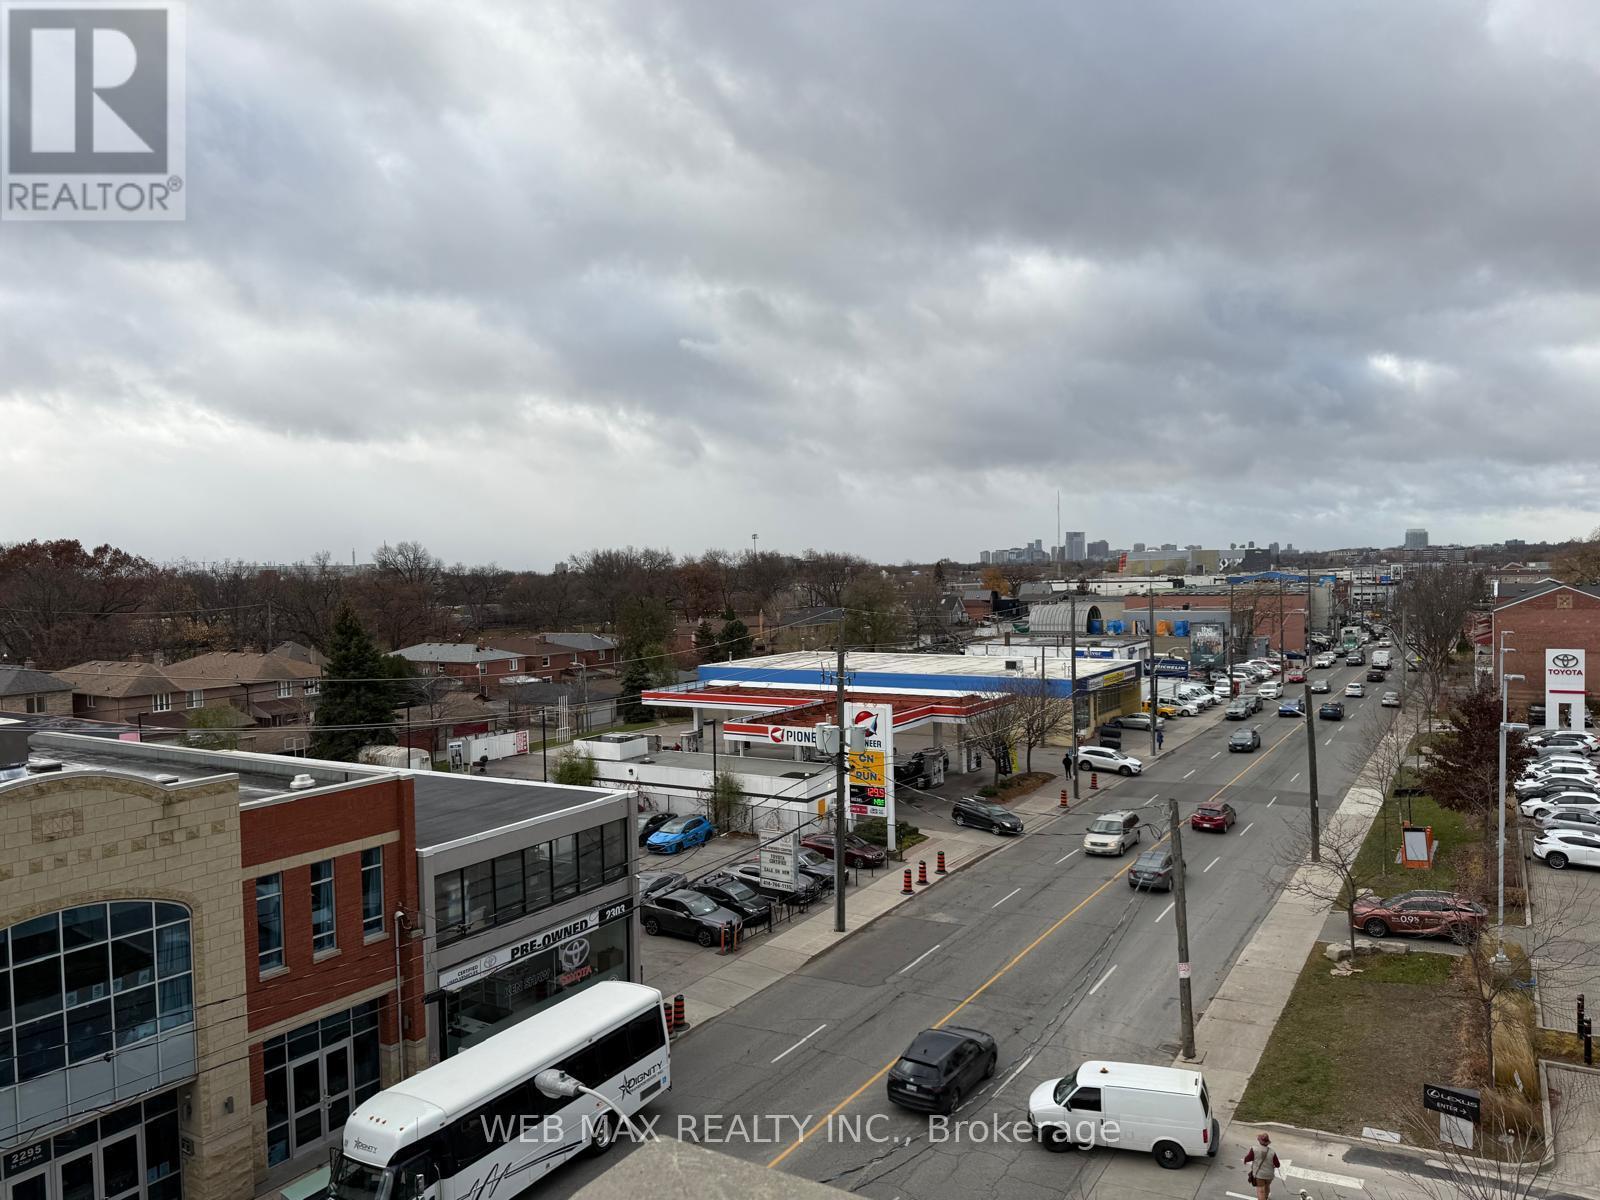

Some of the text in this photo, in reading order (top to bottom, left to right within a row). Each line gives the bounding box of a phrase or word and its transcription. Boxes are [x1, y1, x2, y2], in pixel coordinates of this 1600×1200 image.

[786, 730, 816, 743] PIONE
[859, 754, 874, 763] ON
[605, 904, 625, 920] 2303
[511, 919, 588, 959] PRE-OWNED
[560, 965, 592, 987] TOYOTA
[627, 1060, 663, 1089] DIGNITY
[1437, 1102, 1458, 1112] ENTER
[1441, 1093, 1478, 1108] LEXUS
[12, 1145, 42, 1164] 2295
